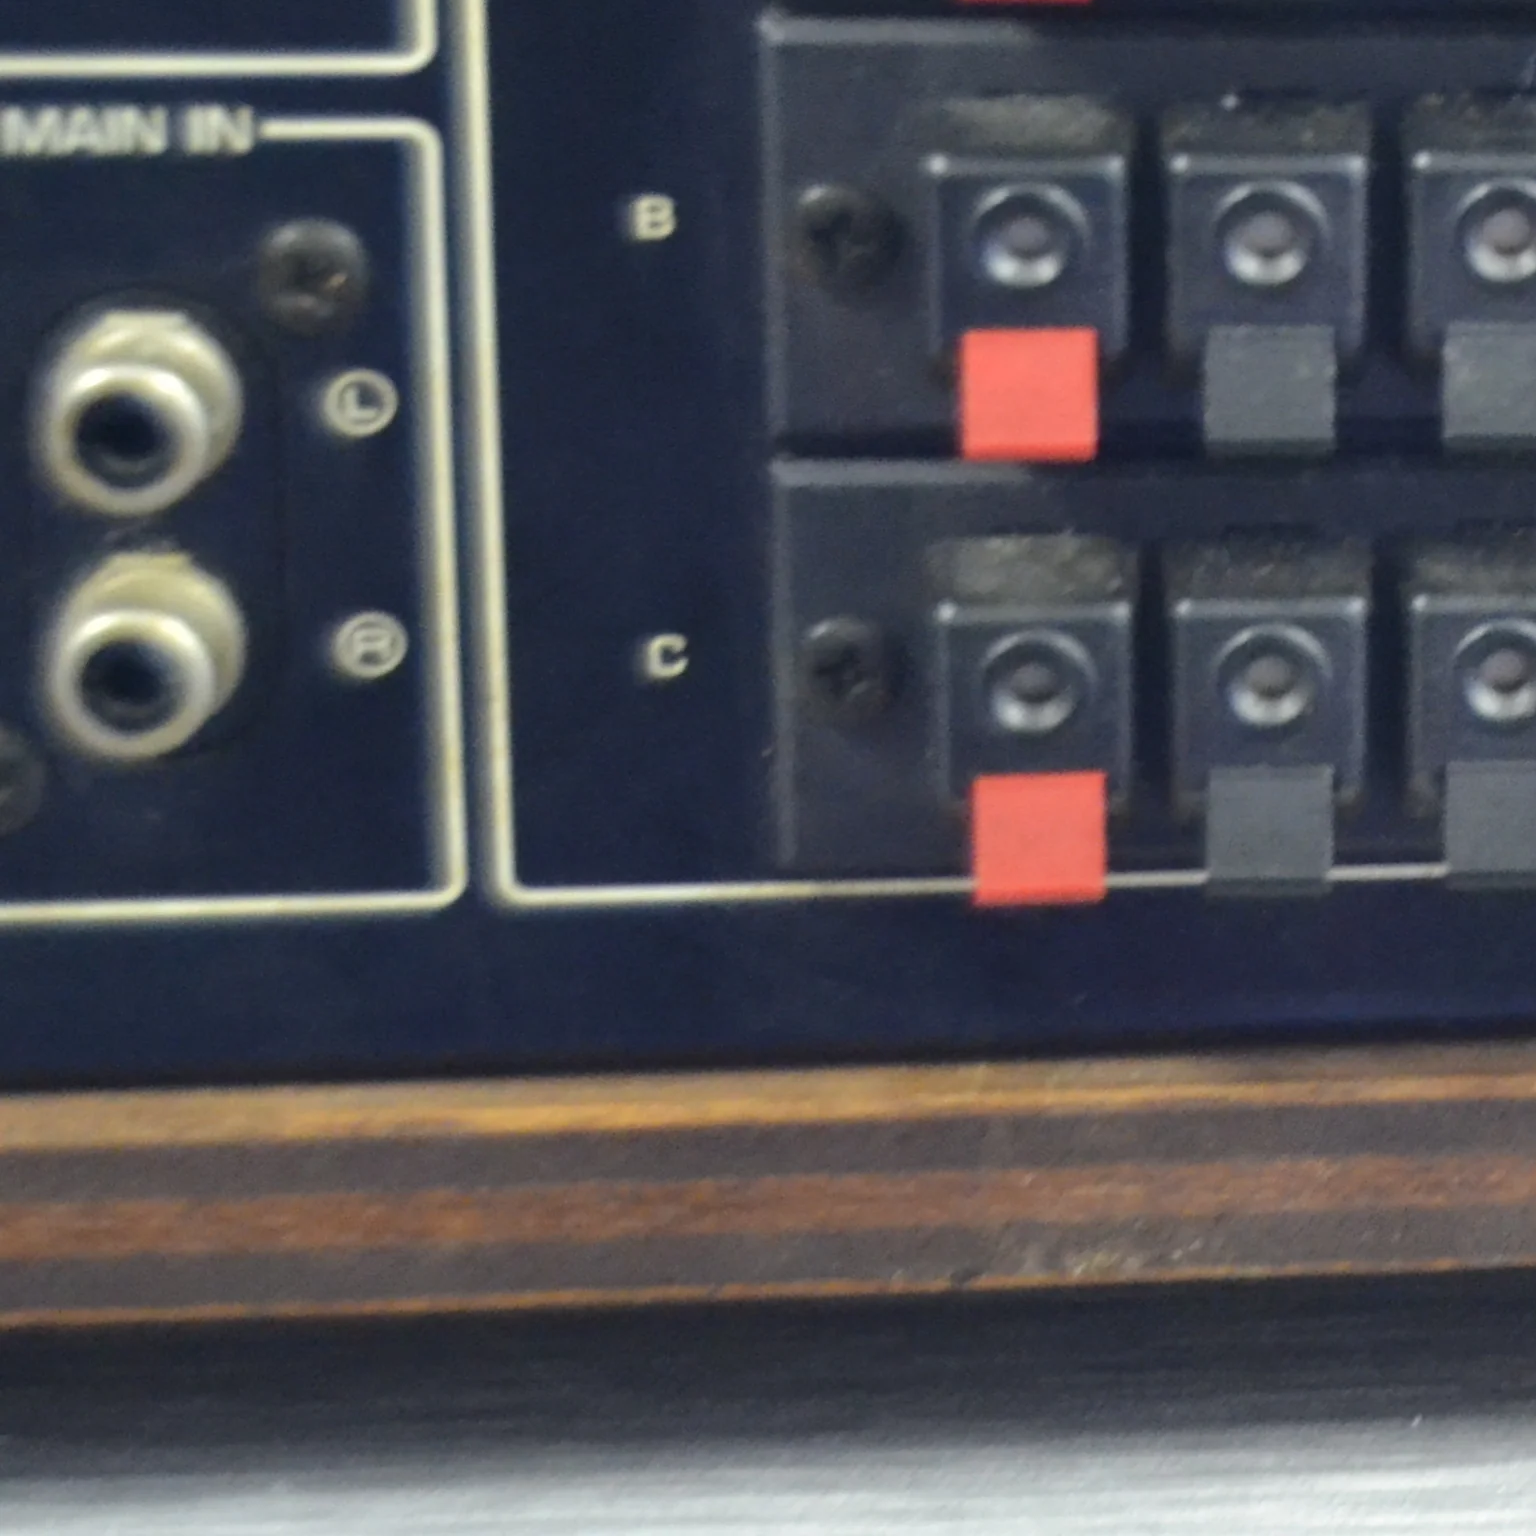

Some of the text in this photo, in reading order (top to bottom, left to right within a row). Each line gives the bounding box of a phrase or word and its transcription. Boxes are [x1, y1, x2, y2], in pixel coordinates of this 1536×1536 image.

[0, 105, 259, 155] MAIN IN
[631, 195, 675, 239] B
[644, 634, 687, 678] C
